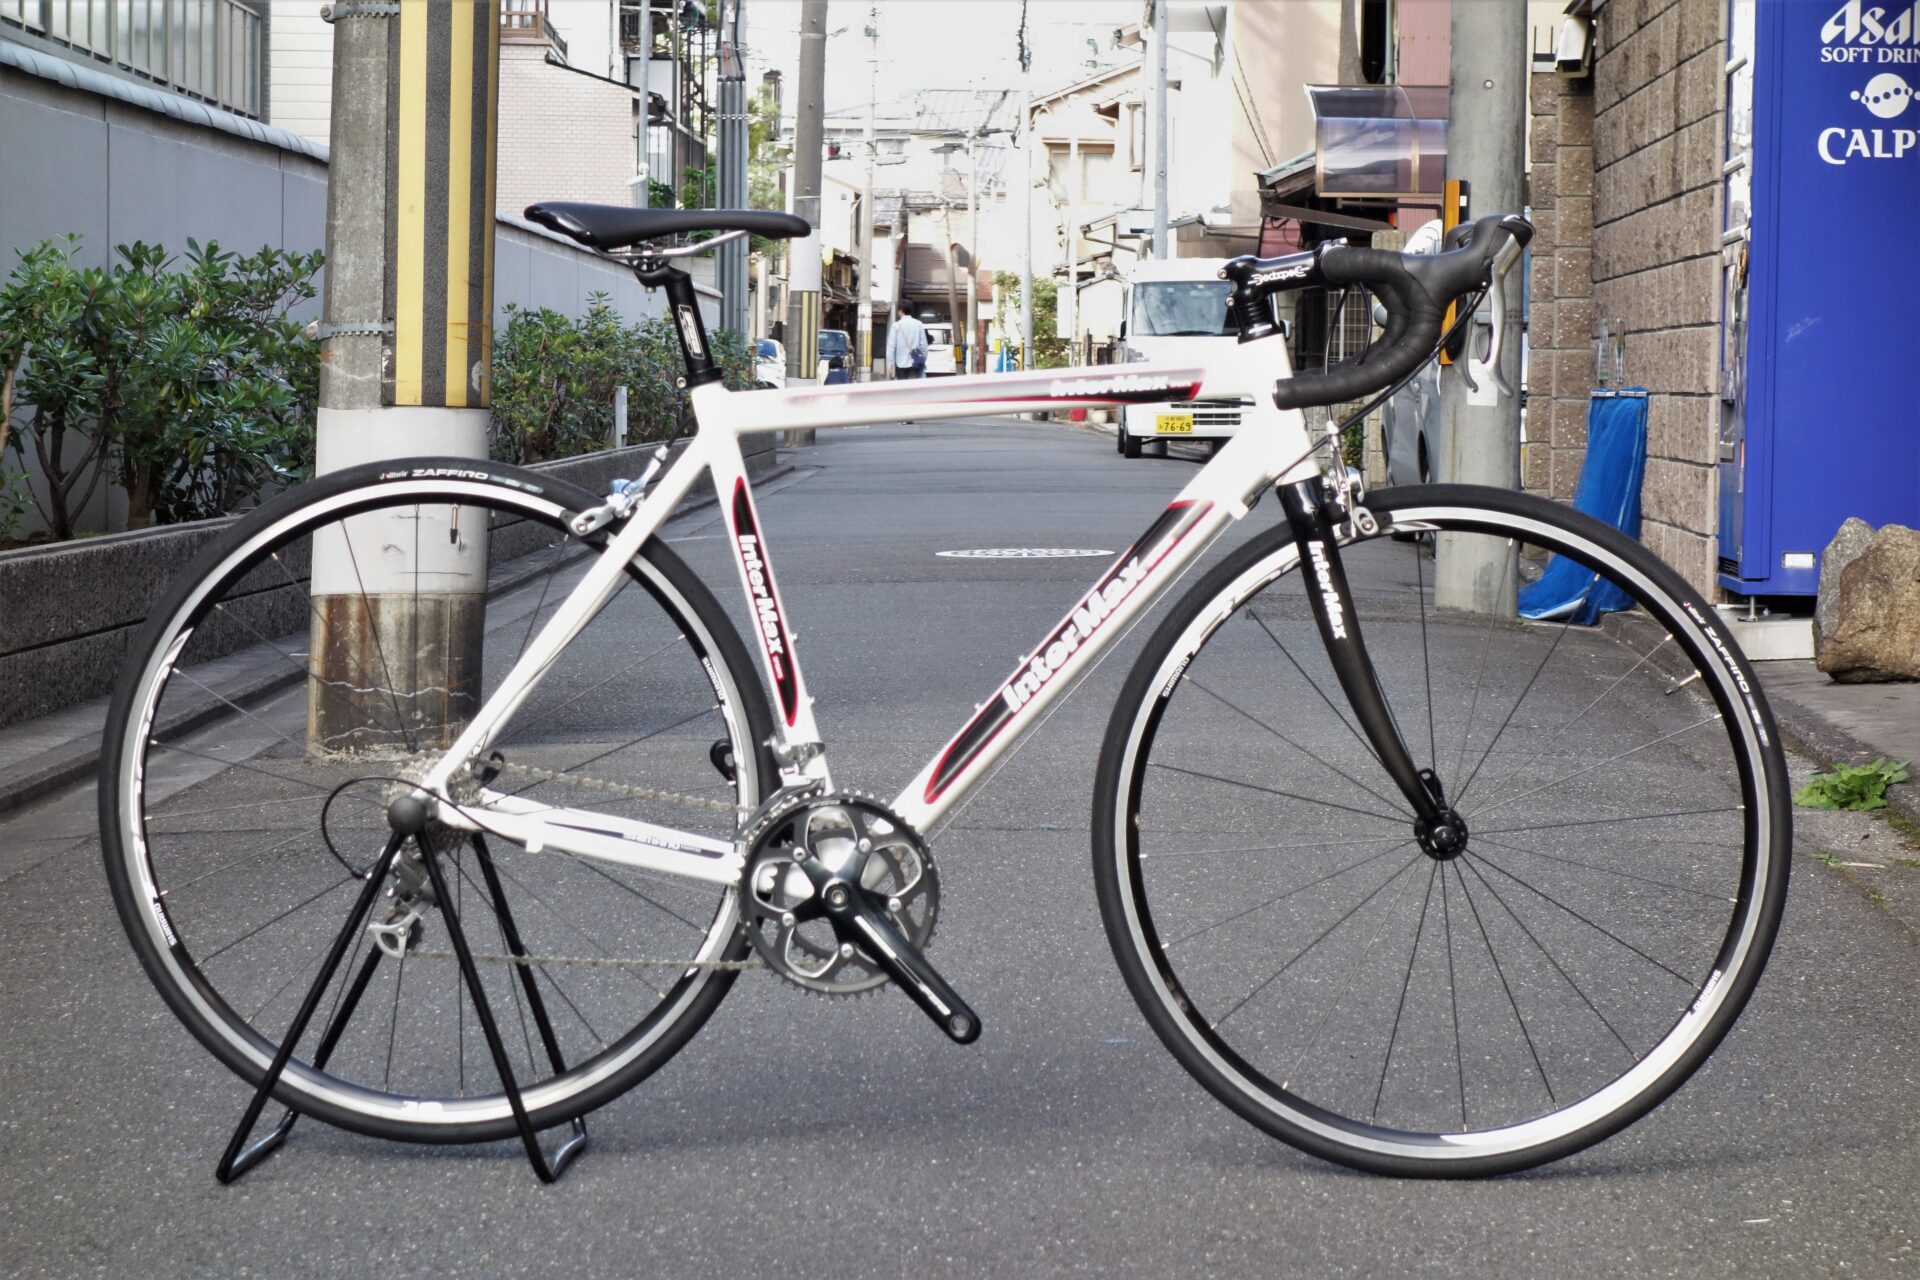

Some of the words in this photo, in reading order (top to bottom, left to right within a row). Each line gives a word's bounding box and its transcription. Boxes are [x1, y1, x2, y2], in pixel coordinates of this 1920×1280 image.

[1821, 47, 1872, 63] SOFT
[1817, 127, 1920, 165] CALP
[1164, 422, 1191, 432] 76-69
[412, 468, 489, 480] ZAFFIRO
[702, 656, 725, 701] SHIMANO
[1161, 656, 1191, 698] SHIMANO
[1704, 627, 1750, 693] ZAFFIRO
[154, 903, 177, 946] SHIMANO
